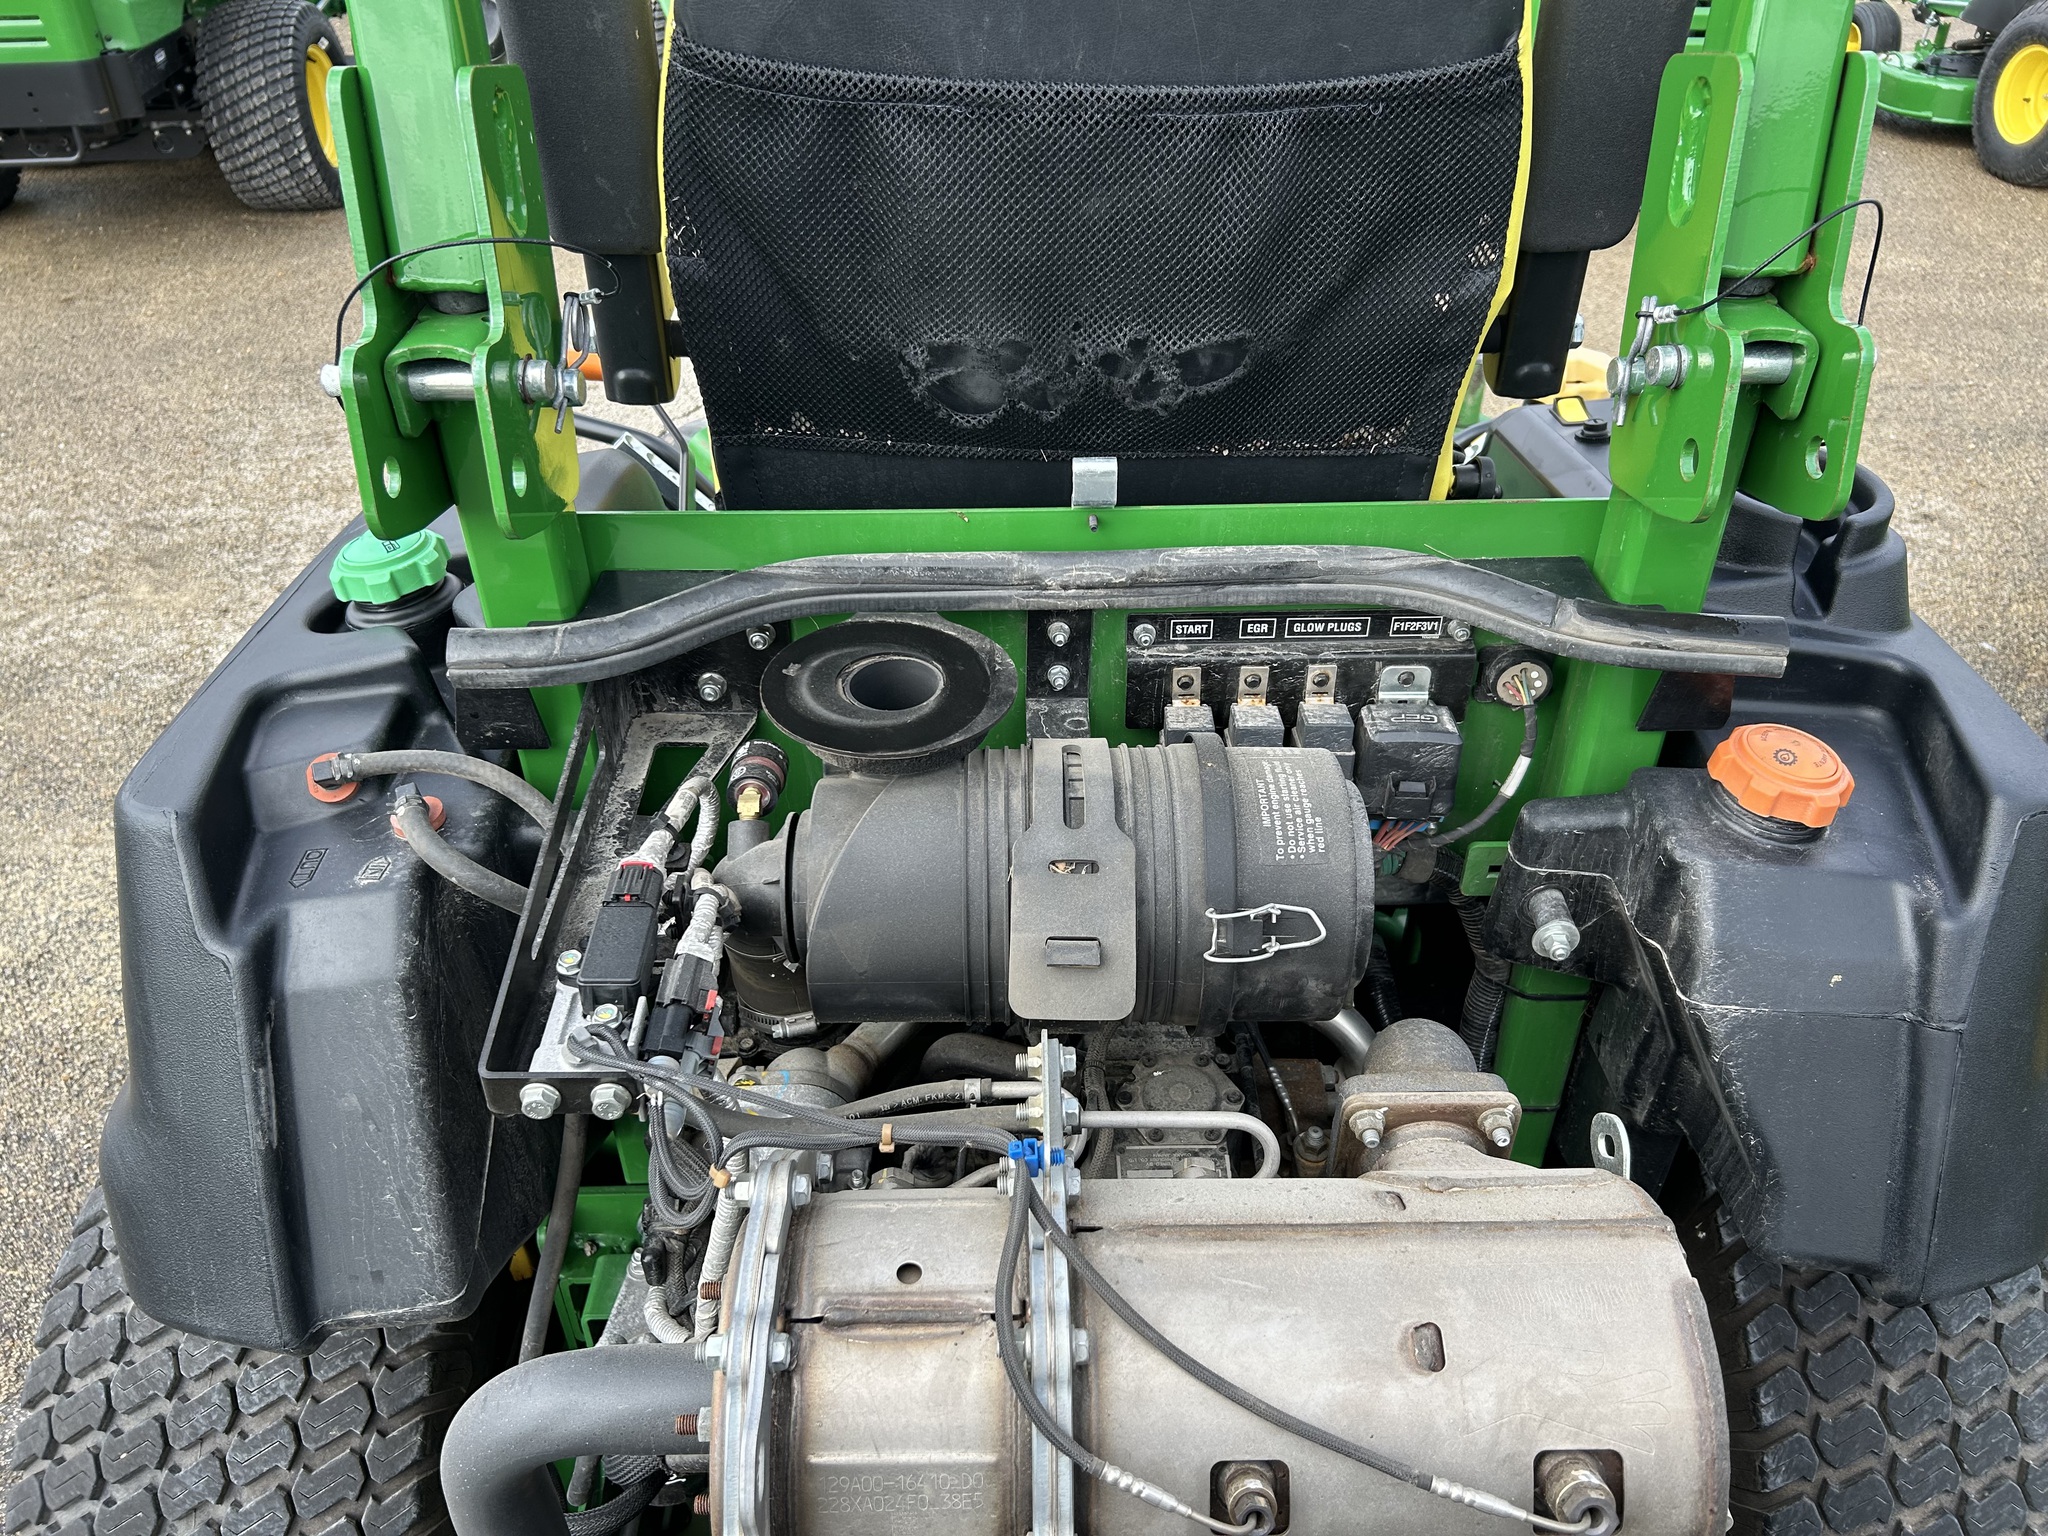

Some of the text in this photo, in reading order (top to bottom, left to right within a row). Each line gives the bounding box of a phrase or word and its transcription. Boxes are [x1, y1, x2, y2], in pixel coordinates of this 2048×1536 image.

[1175, 624, 1208, 635] START
[1247, 622, 1269, 633] EGR
[1293, 621, 1362, 633] GLOW PLUGS
[1393, 620, 1438, 632] F1F2F3V1
[1390, 713, 1438, 724] GEP
[1278, 773, 1290, 801] starting
[1286, 775, 1299, 801] cleaner
[1256, 779, 1271, 827] IMPORTANT
[1267, 784, 1280, 809] engine
[1284, 803, 1292, 818] use
[1293, 804, 1302, 815] air
[1295, 769, 1316, 853] when gauge reaches
[1272, 811, 1285, 845] prevent
[1286, 821, 1295, 837] not
[1296, 817, 1306, 853] Service
[1314, 816, 1326, 853] red line
[1287, 839, 1296, 853] Do
[1276, 848, 1285, 861] To
[296, 851, 323, 879] OUT
